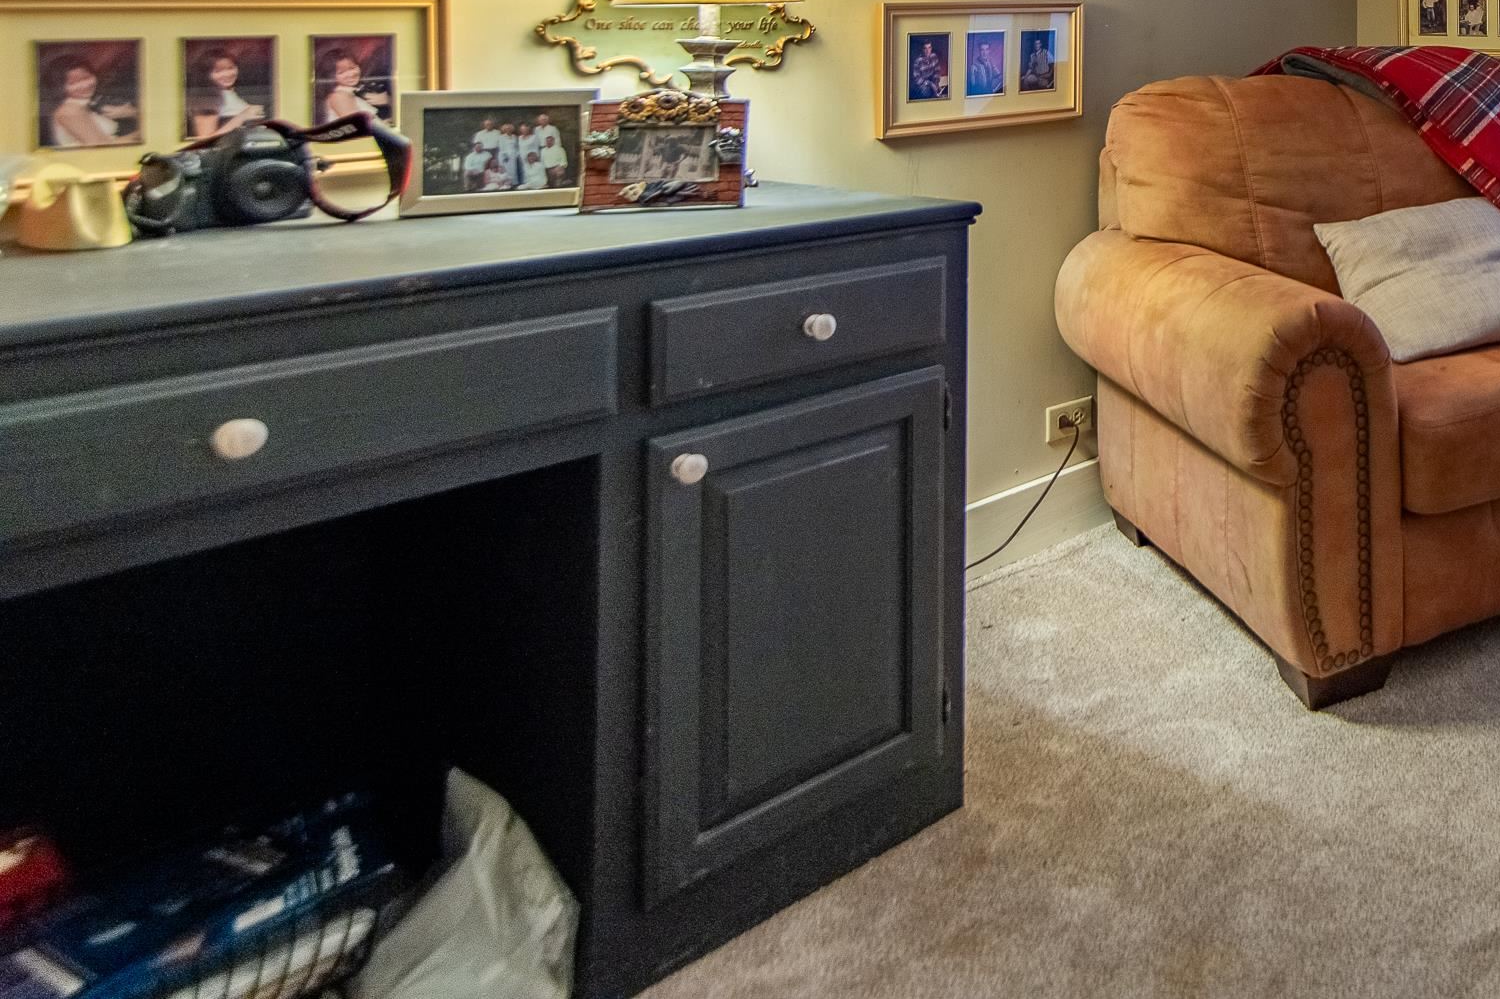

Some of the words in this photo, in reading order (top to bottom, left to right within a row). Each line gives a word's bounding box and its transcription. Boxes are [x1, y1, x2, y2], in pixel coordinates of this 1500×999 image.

[584, 18, 612, 31] One
[618, 15, 647, 31] shoe
[652, 20, 674, 31] can
[724, 20, 755, 34] your
[757, 15, 778, 35] life
